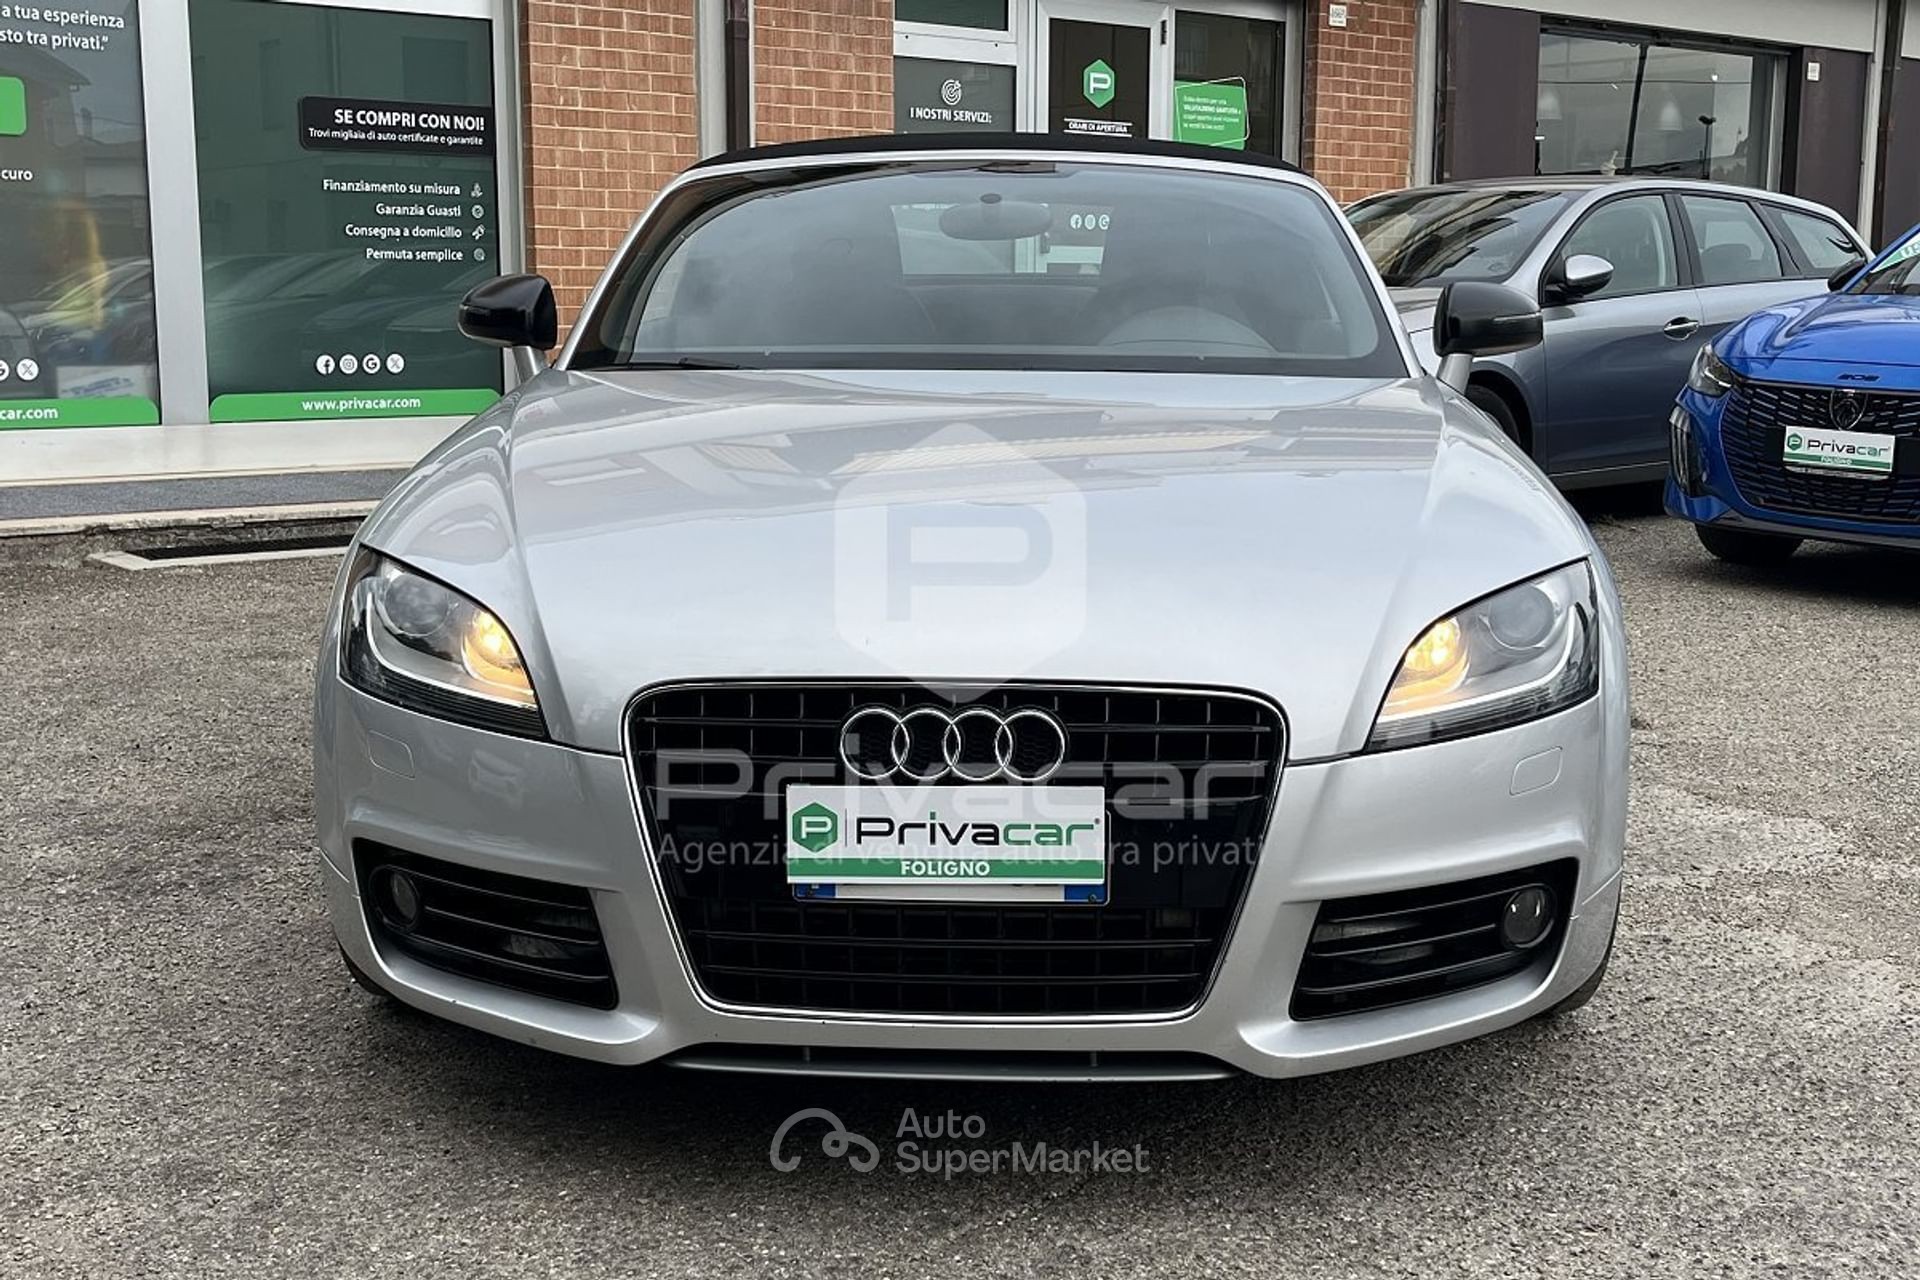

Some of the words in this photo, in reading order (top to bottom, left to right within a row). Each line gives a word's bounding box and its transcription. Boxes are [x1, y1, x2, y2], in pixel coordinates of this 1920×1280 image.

[14, 5, 40, 20] tua
[43, 9, 125, 29] esperienza
[26, 30, 48, 45] tra
[334, 108, 354, 124] SE
[356, 110, 416, 128] COMPRI
[418, 113, 451, 129] CON
[453, 115, 485, 131] NOI!
[915, 107, 952, 121] NOSTRI
[953, 110, 992, 124] SERVIZI:
[308, 127, 331, 139] Trovi
[366, 130, 376, 141] di
[377, 132, 397, 141] auto
[398, 132, 439, 144] certificate
[323, 179, 407, 194] Finanziamento
[408, 184, 422, 194] su
[423, 182, 462, 196] misura
[375, 203, 425, 216] Garanzia
[426, 204, 462, 217] Guasti
[345, 223, 401, 240] Consegna
[403, 228, 410, 238] a
[411, 224, 463, 239] domicilio
[365, 248, 414, 261] Permuta
[415, 249, 464, 264] semplice
[302, 396, 422, 412] www.privacar.com
[0, 408, 59, 420] car.com
[1808, 439, 1889, 457] Privacar
[901, 860, 991, 876] FOLIGNO
